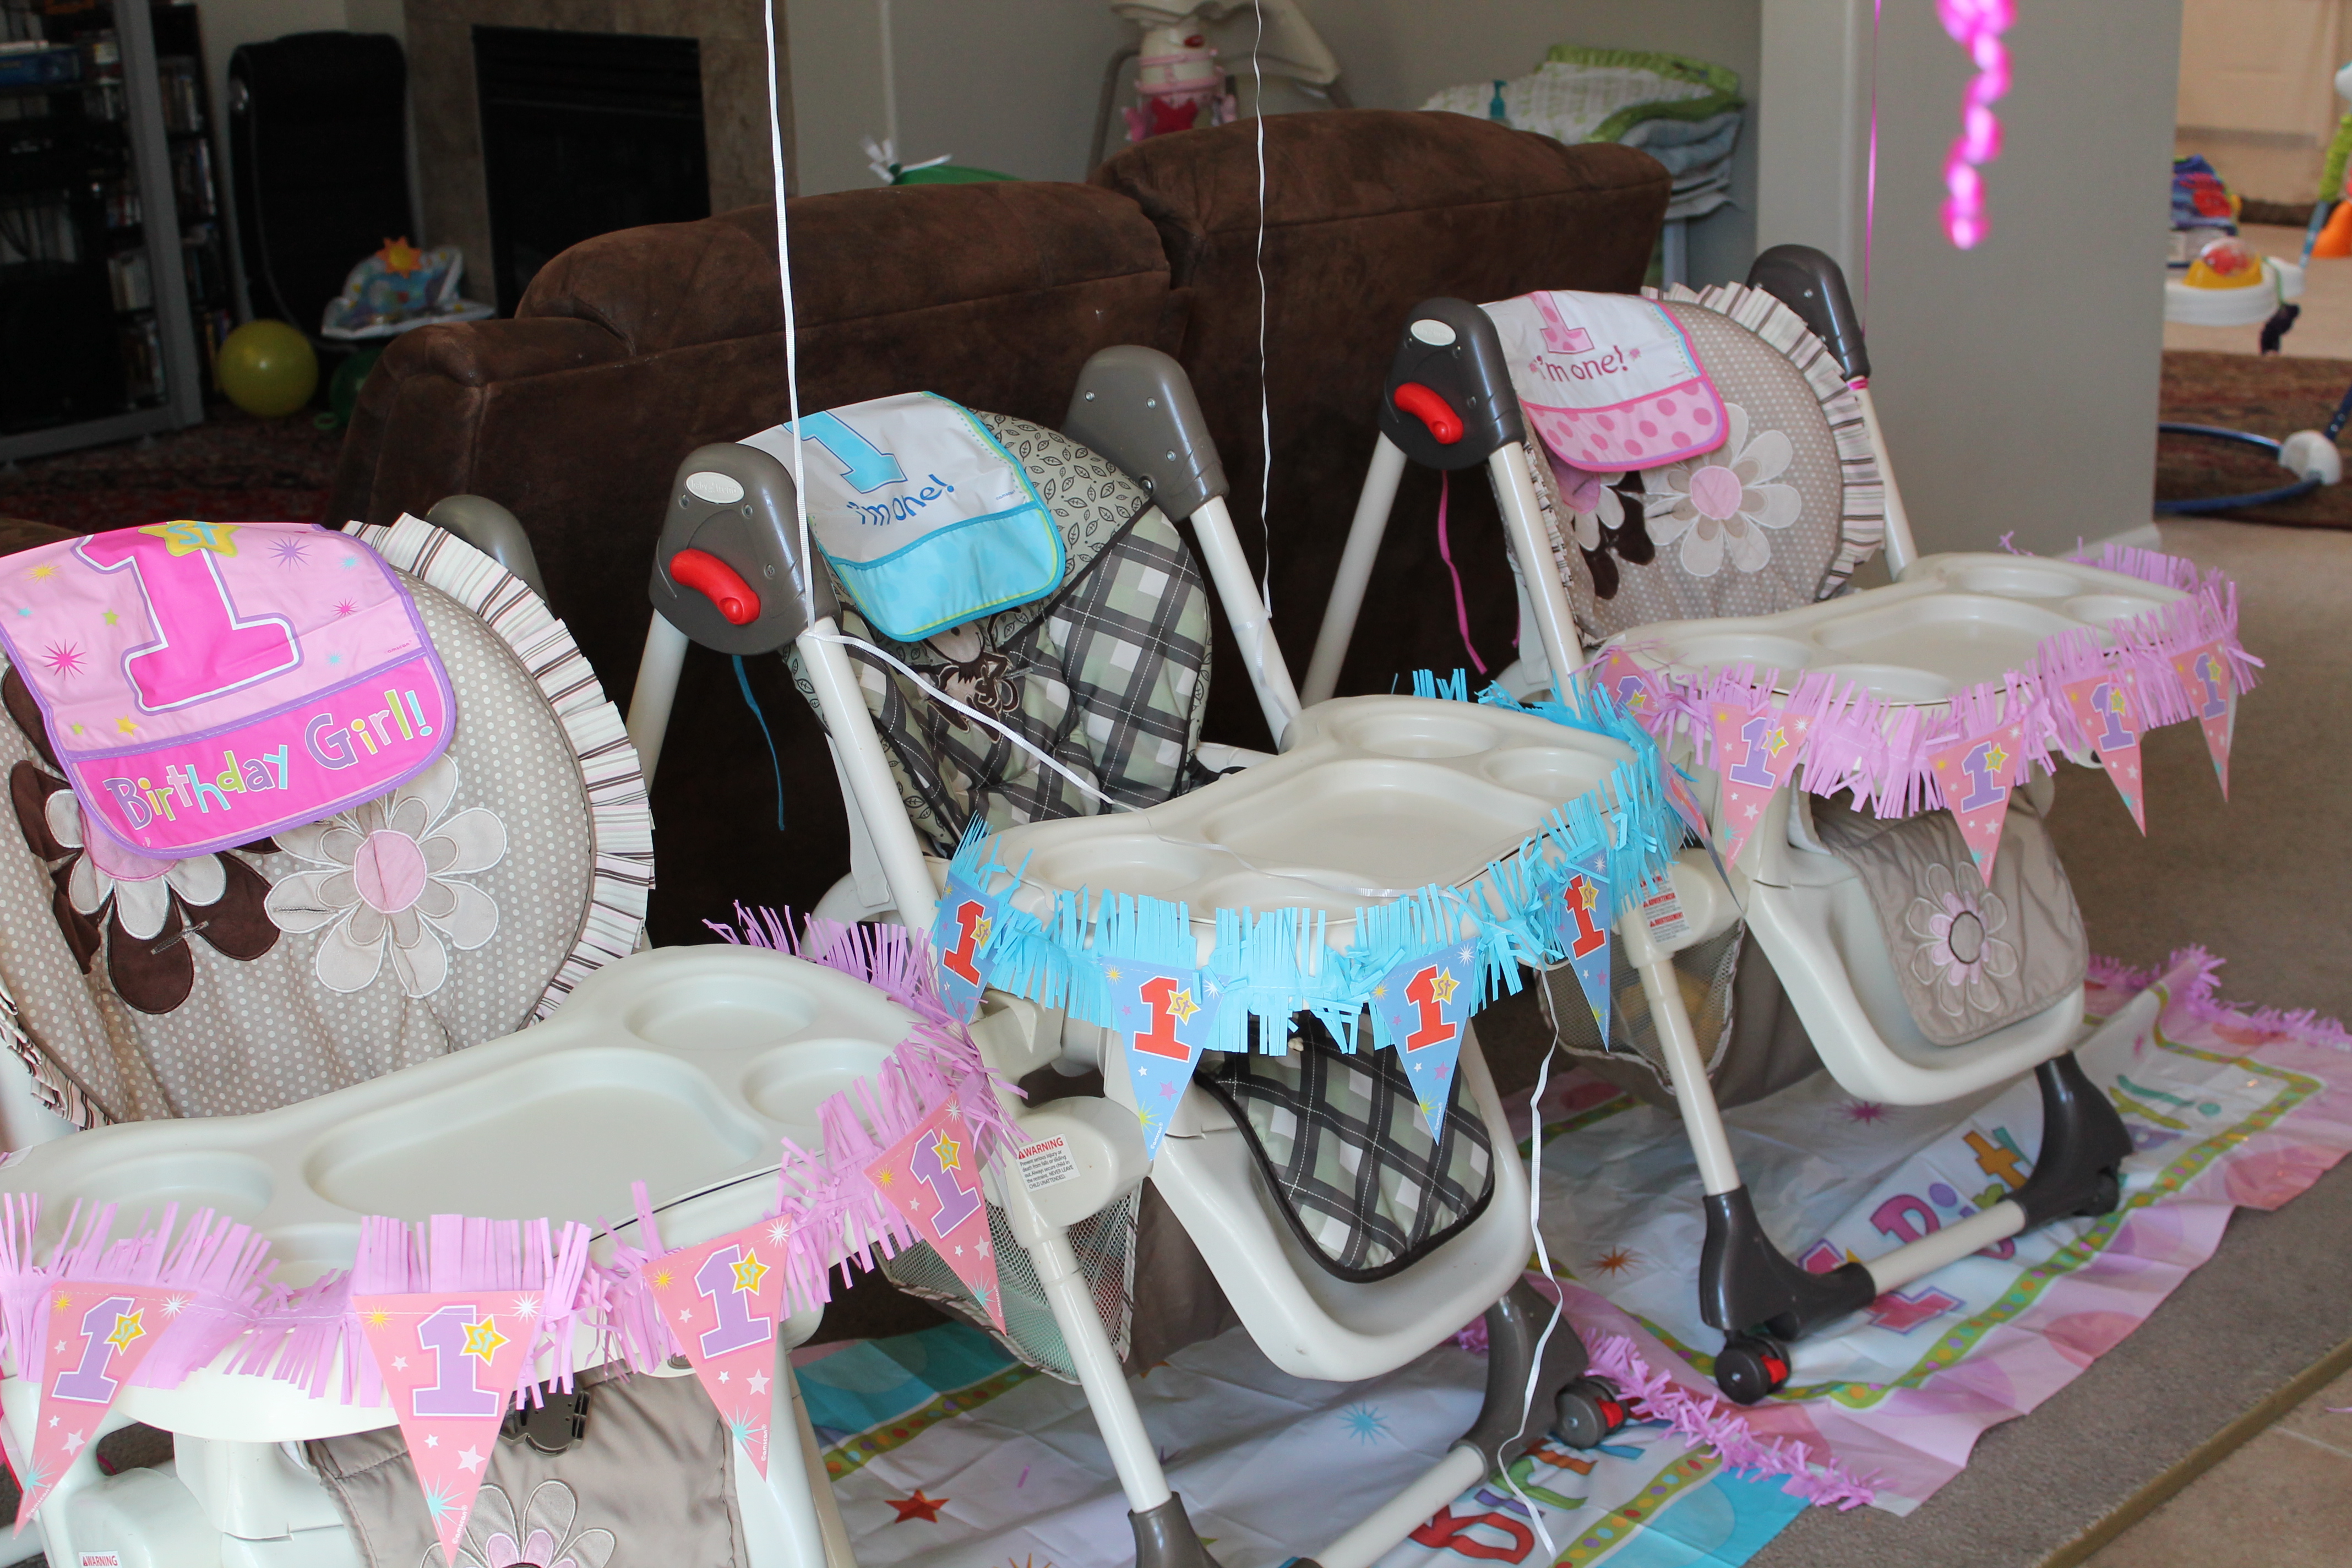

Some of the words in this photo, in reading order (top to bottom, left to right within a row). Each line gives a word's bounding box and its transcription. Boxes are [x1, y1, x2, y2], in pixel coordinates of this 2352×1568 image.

[103, 743, 289, 831] Birthday
[304, 688, 433, 770] Girl!
[1023, 1137, 1064, 1157] WARNING
[1061, 1164, 1074, 1173] LEAVE
[85, 1555, 118, 1567] WARNING
